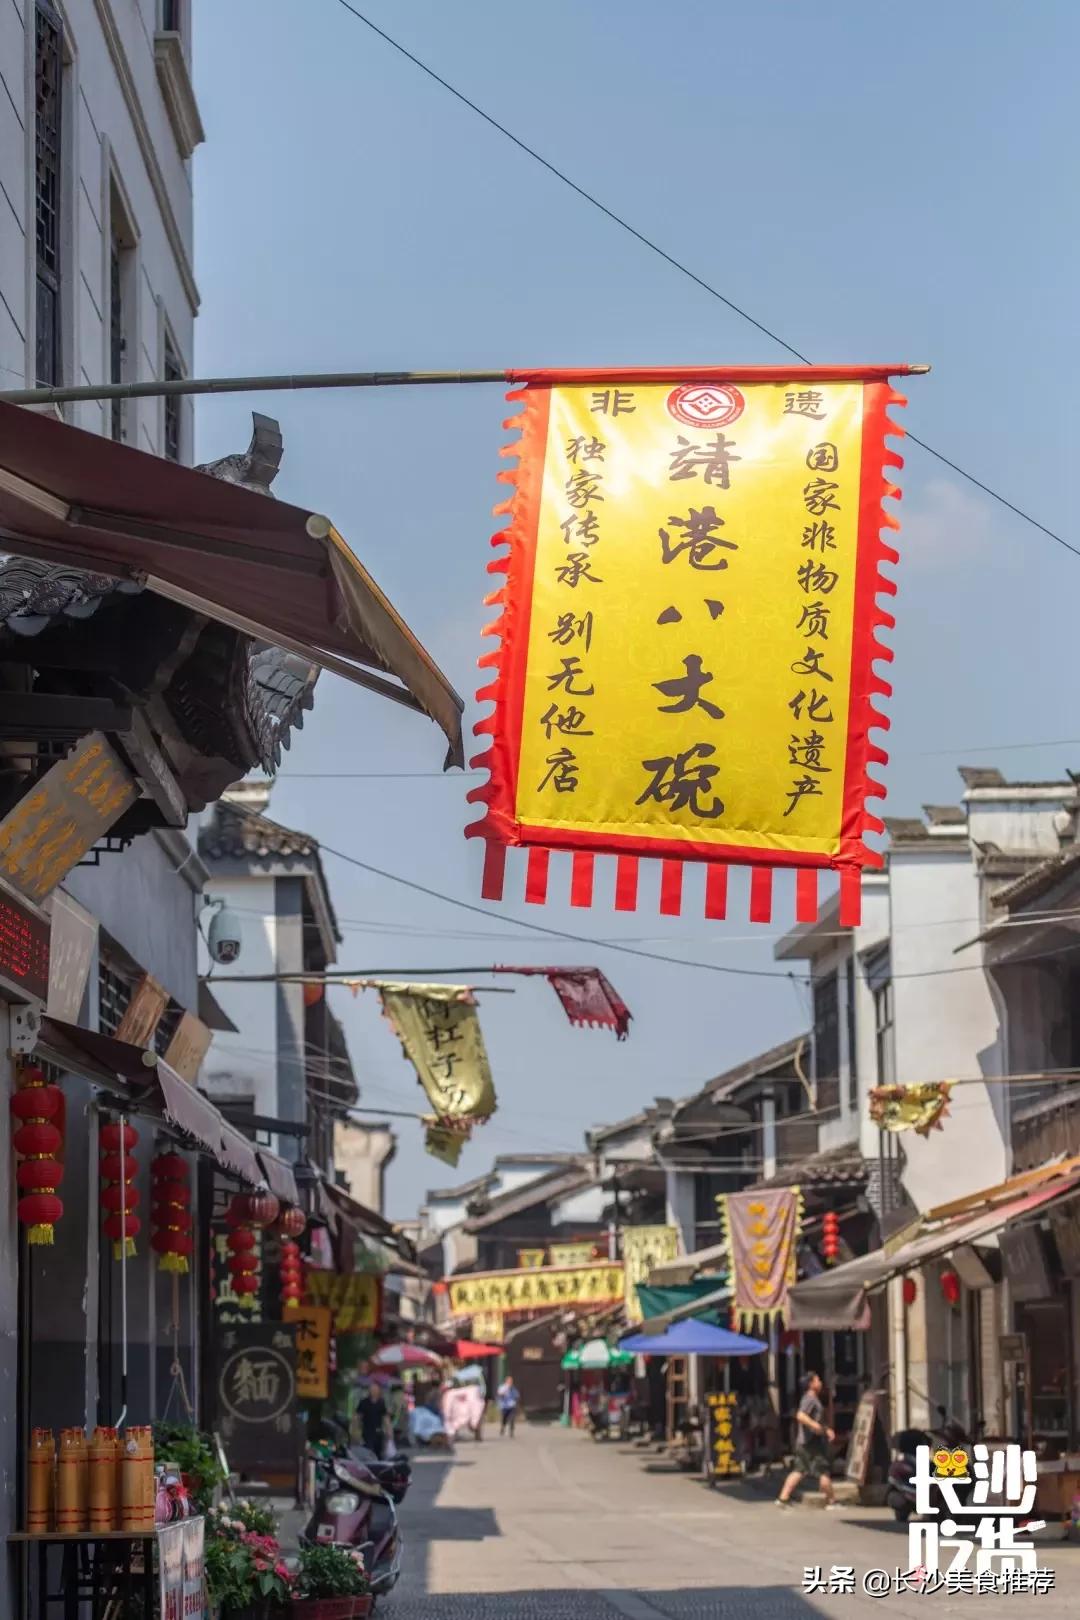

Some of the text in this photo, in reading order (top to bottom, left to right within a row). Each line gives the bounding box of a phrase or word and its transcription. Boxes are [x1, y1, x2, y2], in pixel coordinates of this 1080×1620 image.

[590, 389, 636, 417] 非
[783, 391, 828, 420] 遗
[634, 433, 740, 819] 靖港八大碗
[783, 442, 842, 817] 国家非物质文化遗产
